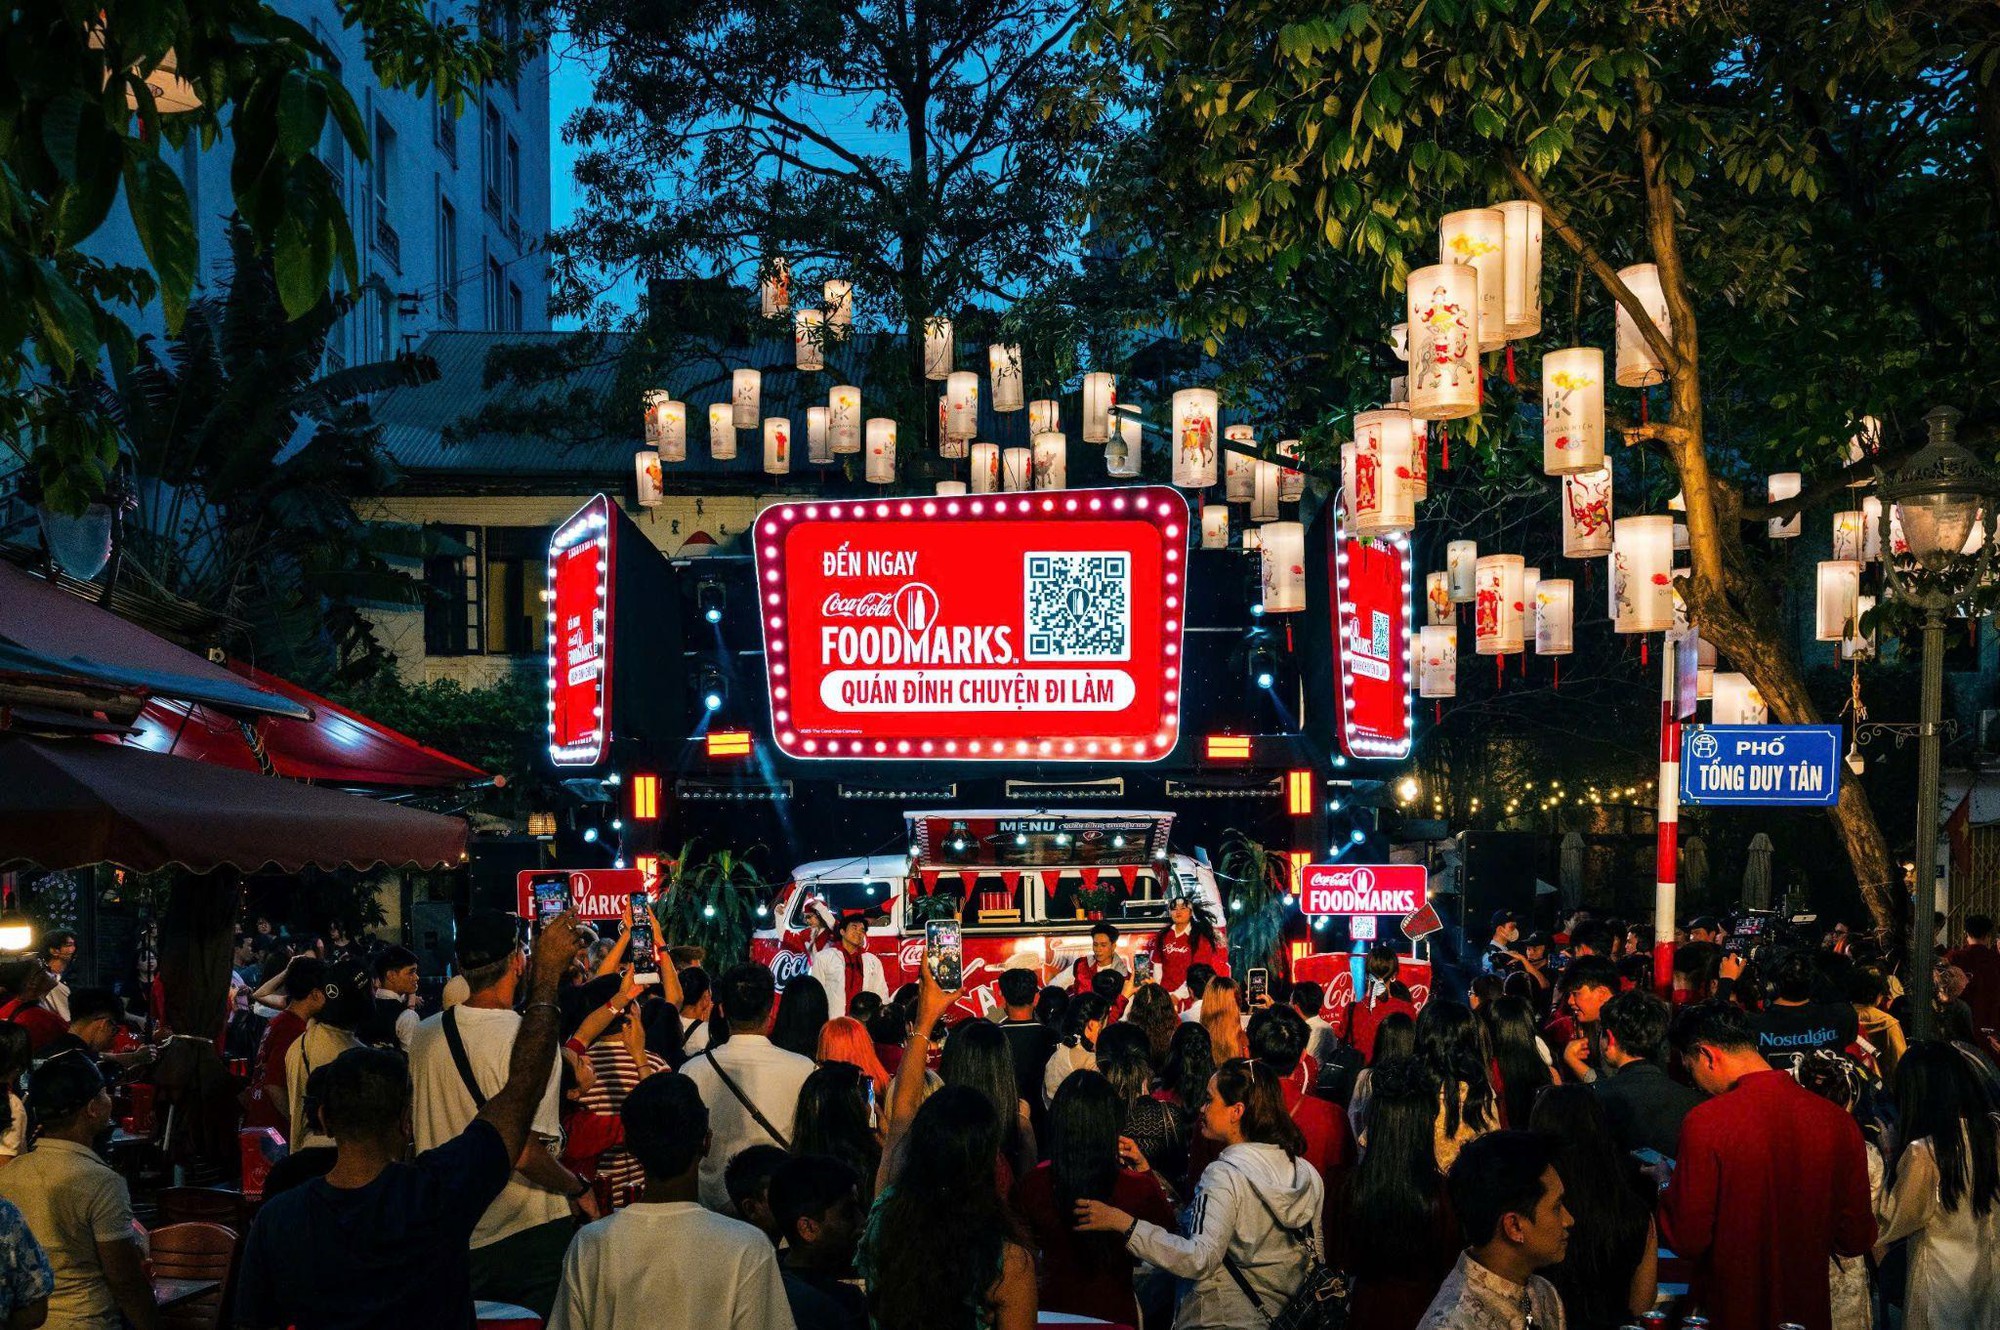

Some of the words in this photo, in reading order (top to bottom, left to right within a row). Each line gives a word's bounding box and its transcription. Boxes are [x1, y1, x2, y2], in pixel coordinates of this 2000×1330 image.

[822, 541, 861, 577] ĐẾN
[867, 551, 918, 576] NGAY
[822, 592, 895, 618] Coca-Cola
[842, 673, 895, 707] QUÁN
[903, 671, 954, 704] ĐỈNH
[959, 673, 1037, 711] CHUYỆN
[1045, 680, 1067, 703] ĐI
[1073, 672, 1114, 702] LÀM
[1736, 736, 1786, 756] PHỐ
[1700, 757, 1745, 791] TỐNG
[1750, 765, 1784, 791] DUY
[1789, 760, 1823, 791] TÂN
[1000, 821, 1055, 832] MENU
